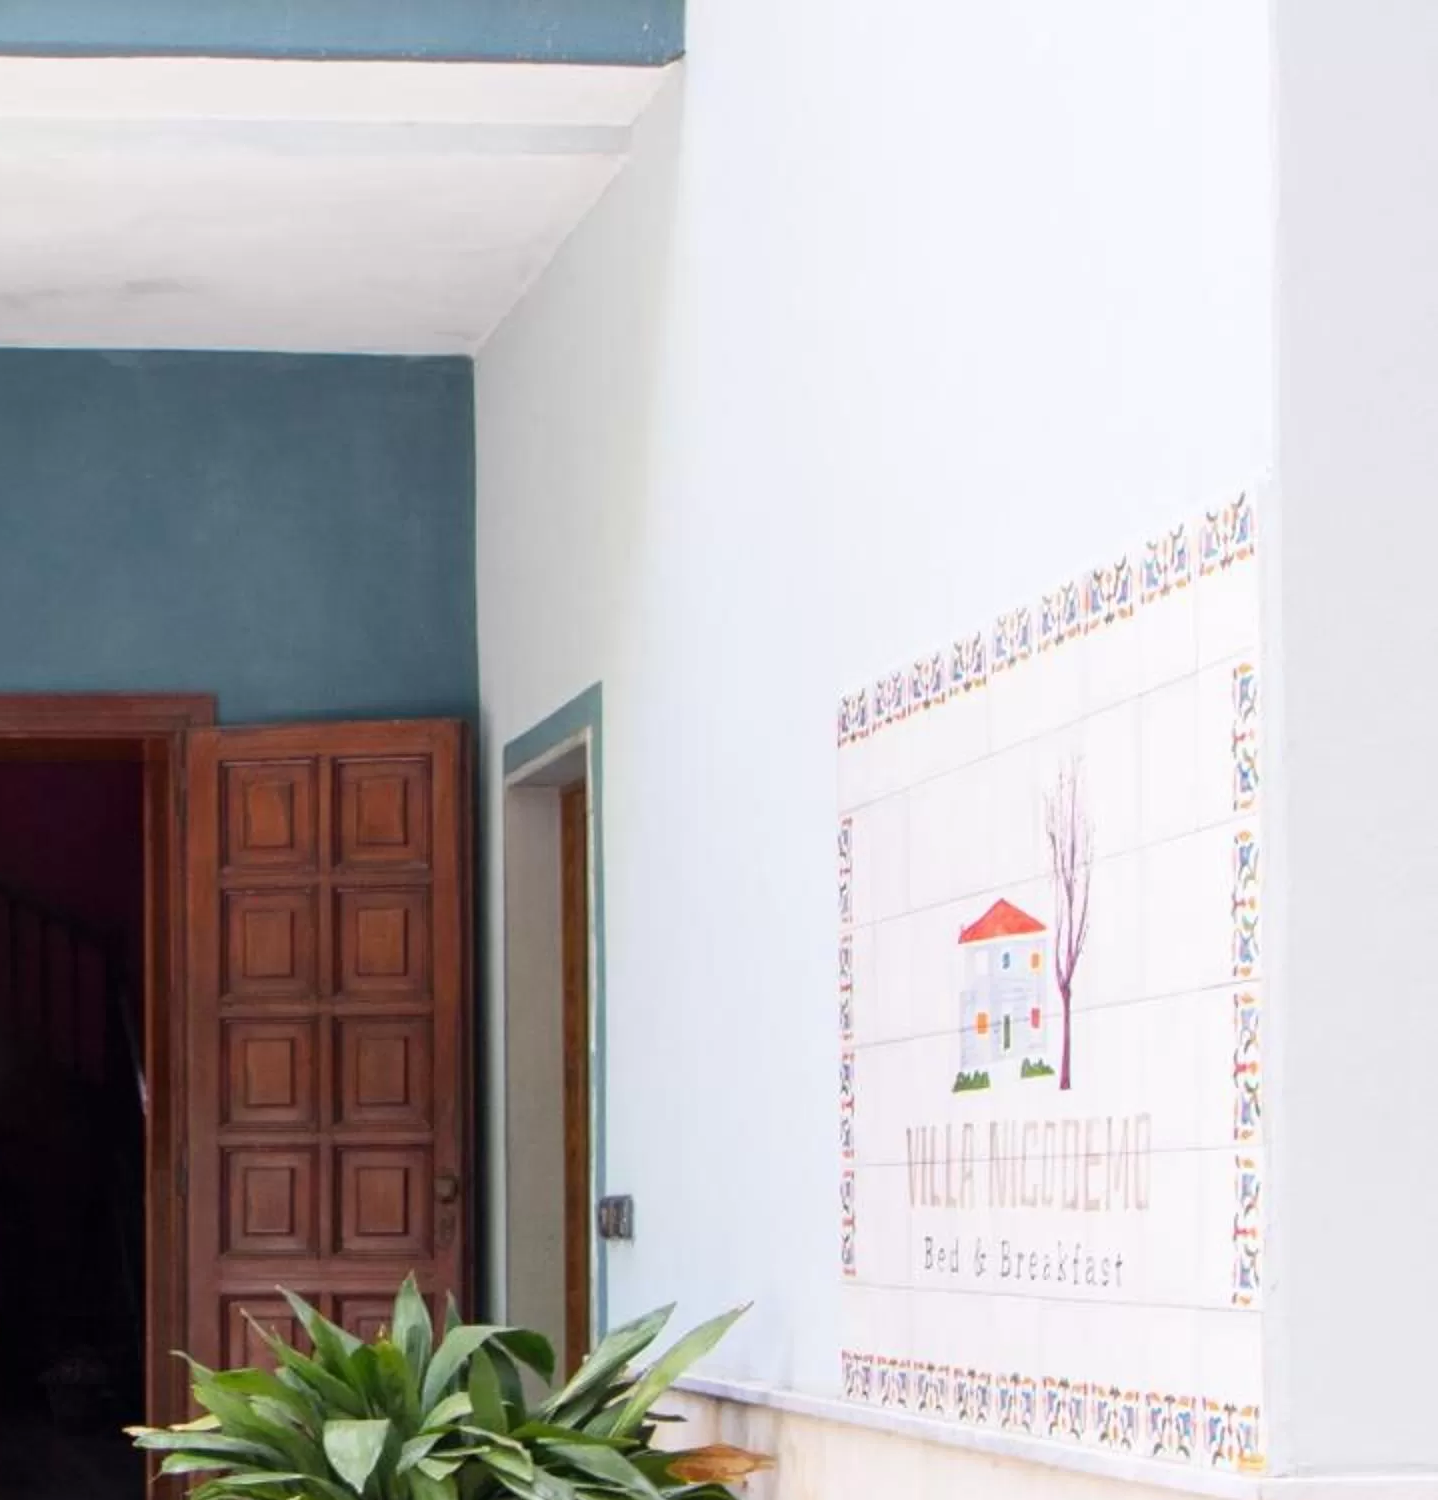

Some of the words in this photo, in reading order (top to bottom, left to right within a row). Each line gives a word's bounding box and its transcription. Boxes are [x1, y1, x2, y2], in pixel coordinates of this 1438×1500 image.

[906, 1122, 974, 1210] VILLA
[989, 1113, 1152, 1212] NICODEMO
[924, 1236, 959, 1274] Bed
[974, 1238, 987, 1277] &
[1000, 1240, 1124, 1287] Breakfast
